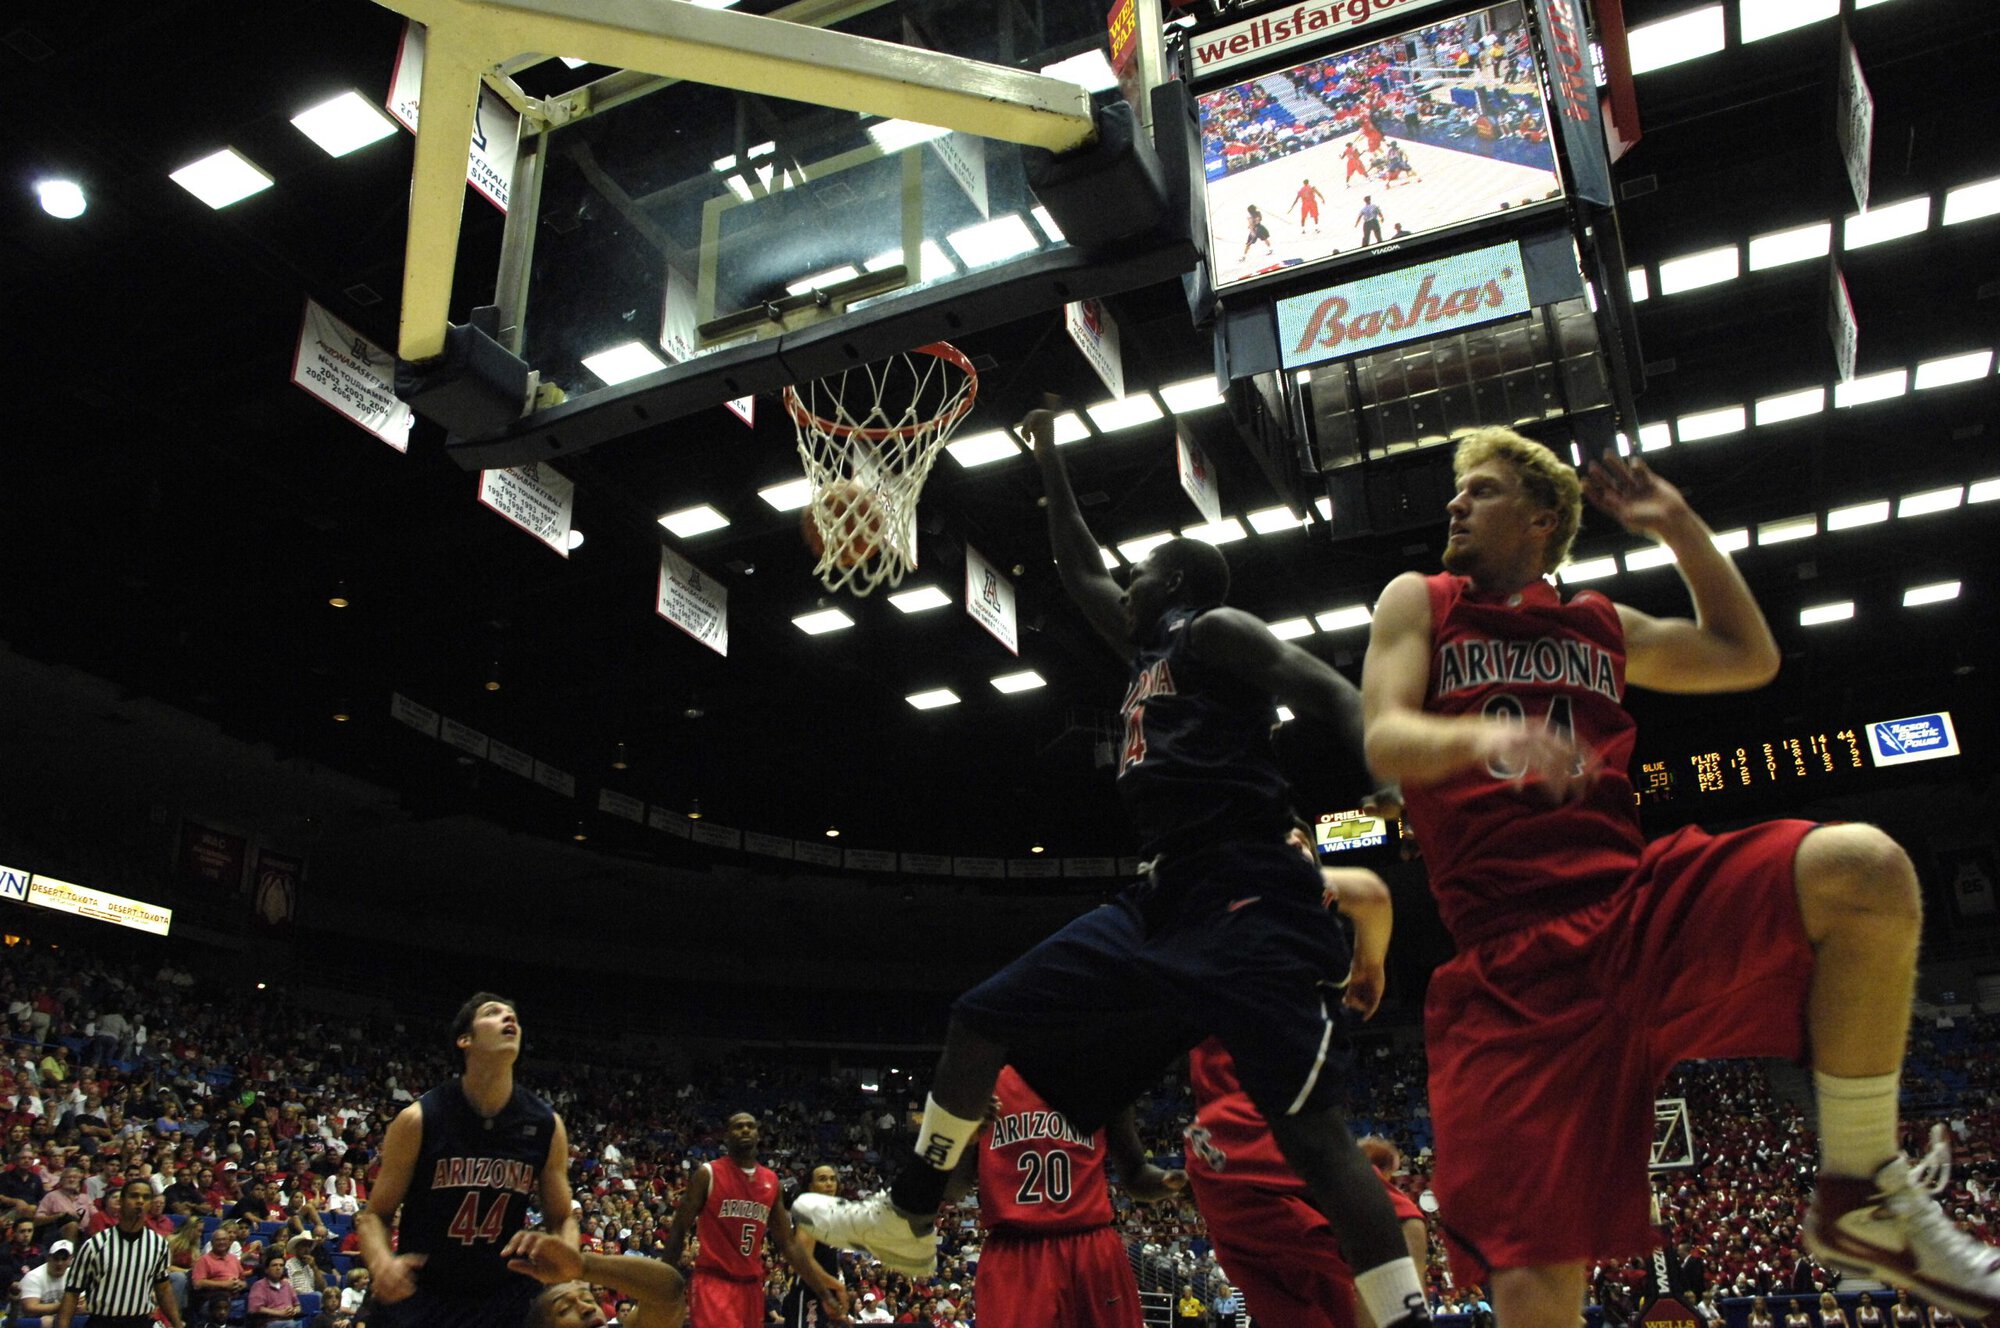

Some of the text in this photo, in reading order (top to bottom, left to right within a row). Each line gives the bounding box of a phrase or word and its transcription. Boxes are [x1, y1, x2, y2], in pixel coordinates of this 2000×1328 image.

[1438, 637, 1620, 704] ARIZONA
[1890, 721, 1930, 734] Tucson
[1898, 727, 1939, 742] Electric
[1903, 736, 1942, 750] Power
[1691, 752, 1721, 766] PLYR
[1762, 743, 1772, 752] 2
[1783, 738, 1800, 750] 12
[1810, 734, 1827, 745] 14
[1837, 729, 1854, 740] 44
[1698, 761, 1719, 774] PTS
[1847, 738, 1857, 749] 7
[1642, 761, 1665, 773] BLUE
[1698, 770, 1722, 783] RBS
[1700, 779, 1725, 793] FLS
[1320, 809, 1366, 823] O'RIEL
[1324, 836, 1382, 853] WATSON
[31, 883, 64, 897] DESERT
[66, 891, 98, 906] TOYOTA
[108, 902, 137, 917] DESERT
[138, 910, 169, 925] TOYOTA
[990, 1111, 1094, 1150] ARIZON
[431, 1157, 534, 1195] ARIZONA
[1016, 1150, 1072, 1204] 20
[447, 1191, 512, 1246] 44
[739, 1223, 757, 1256] 5
